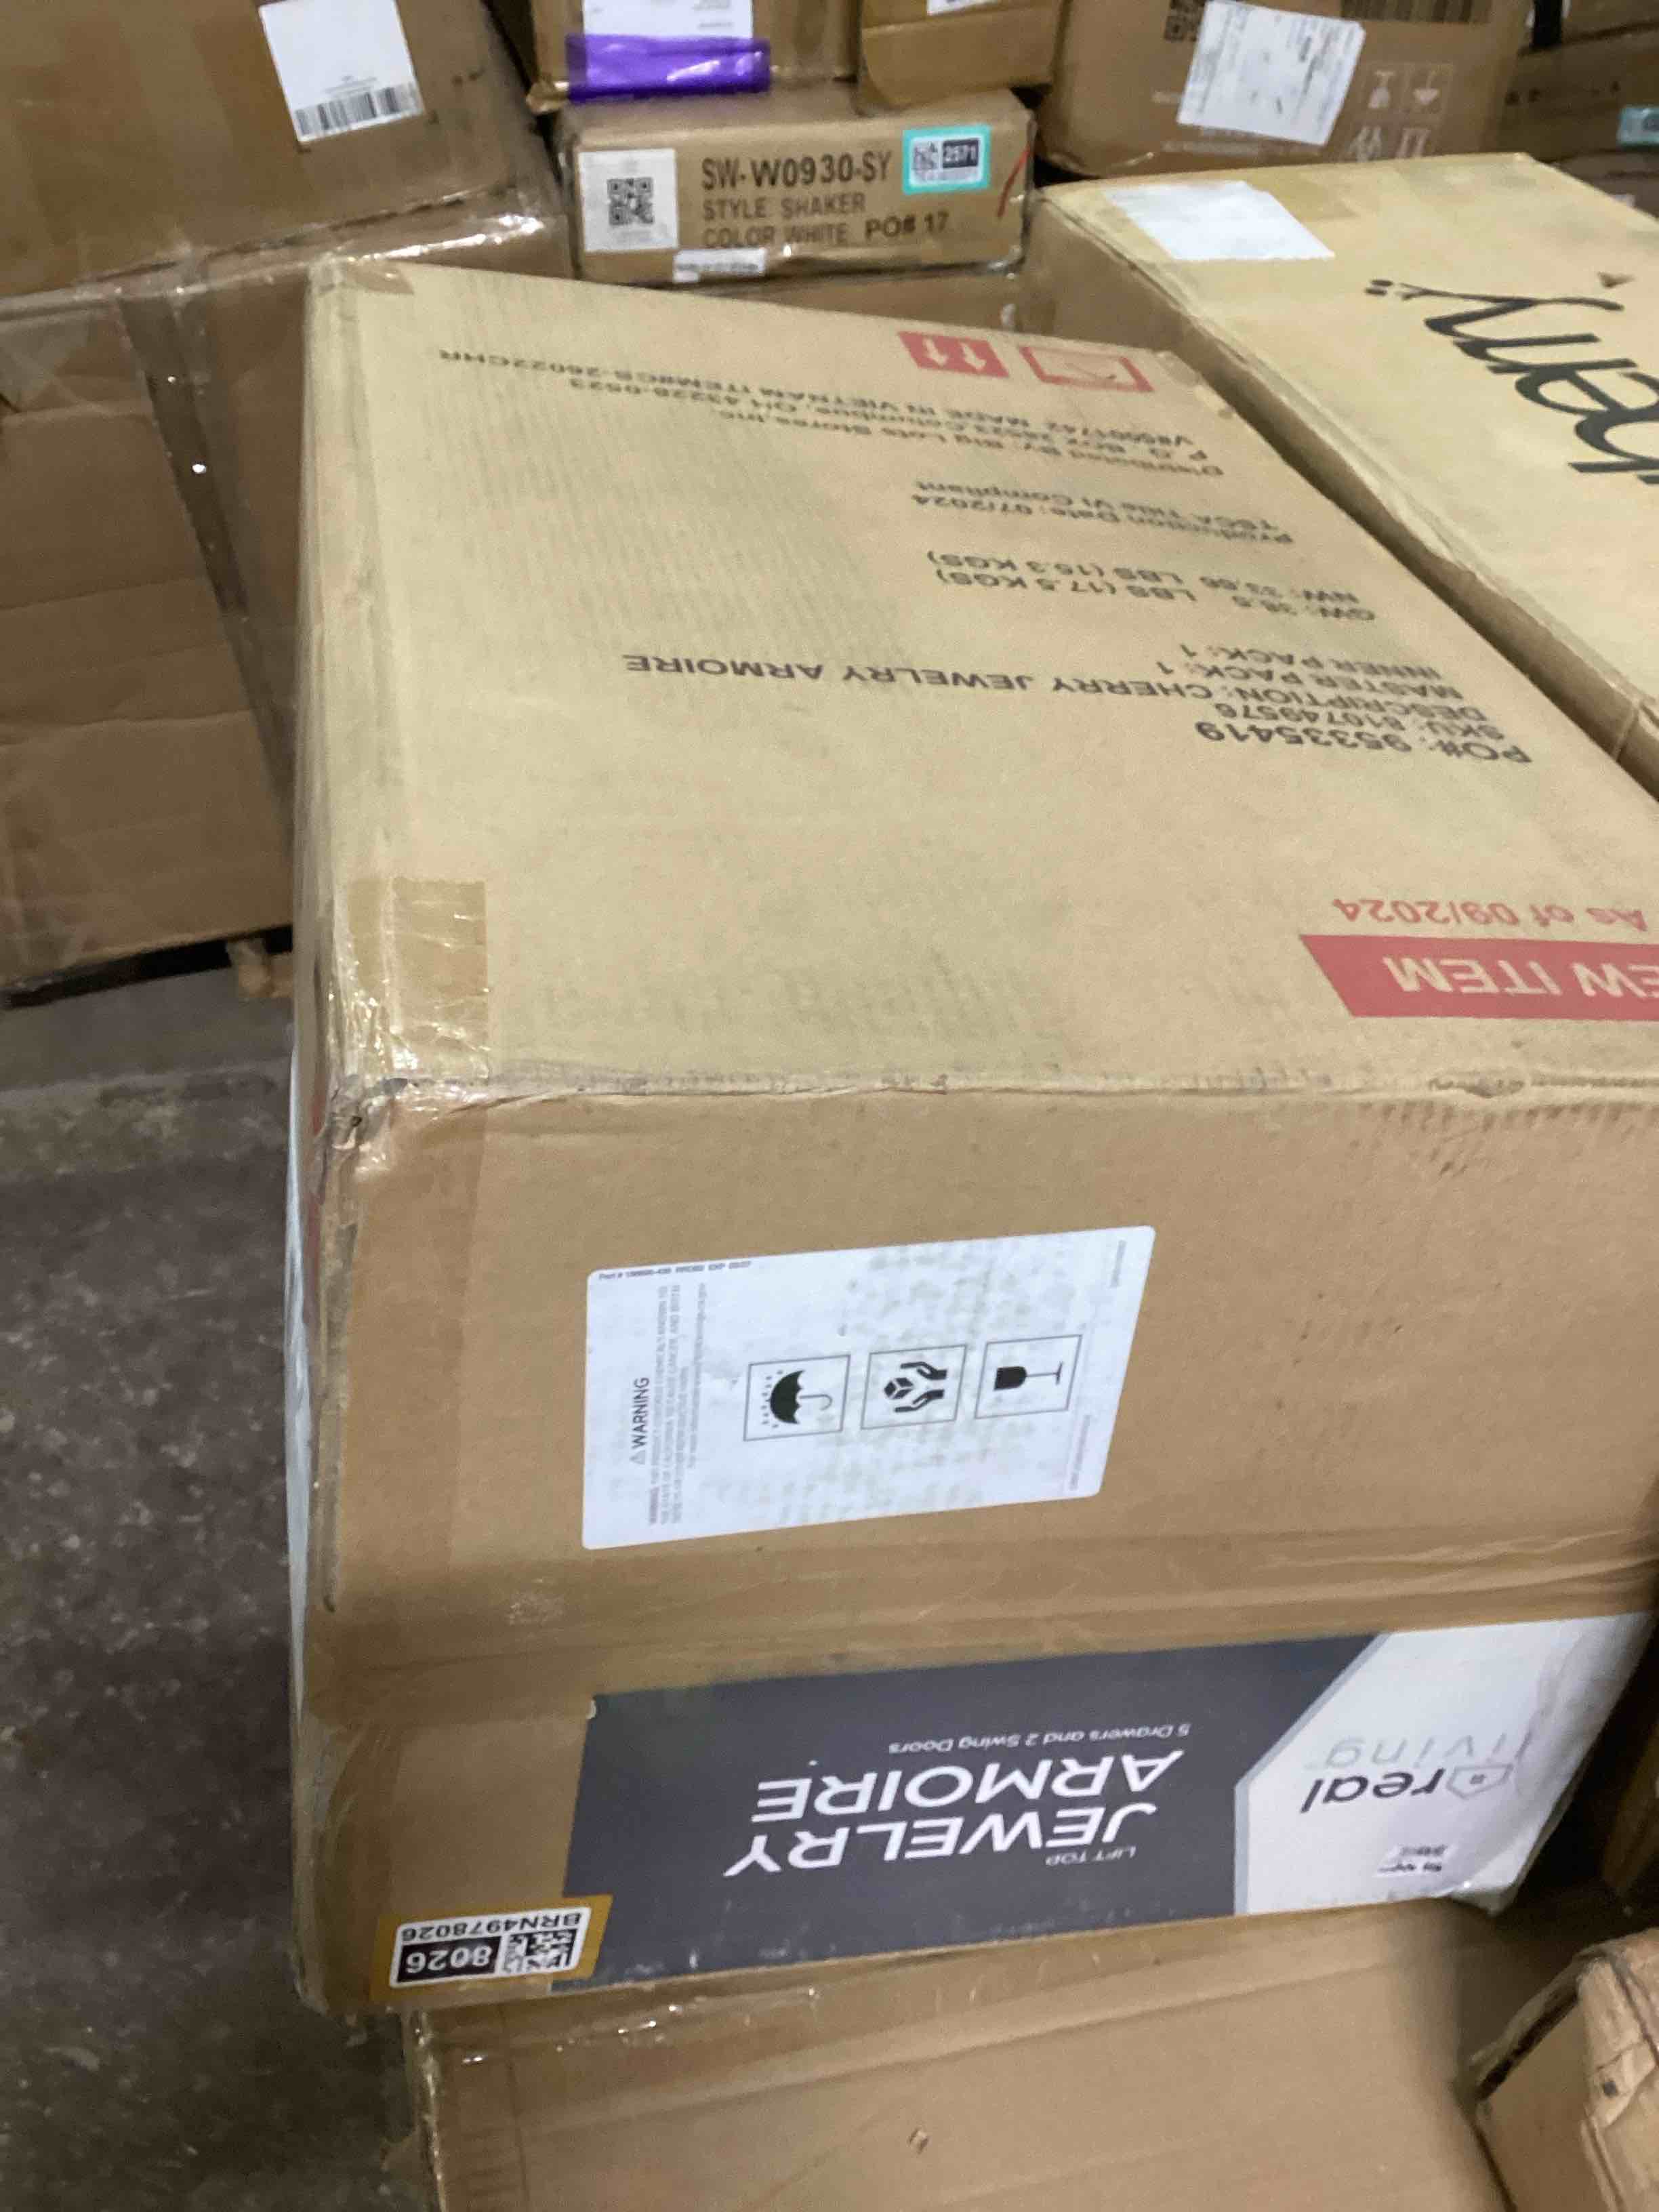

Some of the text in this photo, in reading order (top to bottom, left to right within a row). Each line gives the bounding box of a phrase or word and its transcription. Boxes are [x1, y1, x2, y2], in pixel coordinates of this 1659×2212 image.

[701, 150, 892, 190] SW-W0930-SY
[703, 192, 867, 221] STYLE SHAKER
[703, 223, 848, 248] COLOR WHITE
[924, 211, 949, 234] 17
[759, 387, 901, 411] VIETNAM
[911, 494, 1033, 516] 07/2024
[913, 480, 1073, 507] Compliant
[927, 550, 1017, 572] KGS)
[937, 569, 1028, 590] KGS)
[1113, 567, 1183, 586] LBS
[1126, 585, 1197, 602] LBS
[1179, 644, 1441, 680] INNER PACK: 1
[622, 654, 1487, 722] DESCRIPTION: CHERRY JEWELRY ARMOIRE
[1155, 661, 1463, 700] MASTER PACK: 1
[1194, 721, 1532, 764] PO#: 95335419
[1420, 721, 1506, 741] SKU:
[1332, 898, 1647, 933] As of 09/2024
[1382, 956, 1563, 996] ITEM
[630, 1376, 650, 1449] WARNING
[888, 1723, 1191, 1754] 5 Drawers and 2 Swing Doors
[750, 1750, 1184, 1822] ARMOIRE
[1299, 1768, 1446, 1814] real
[722, 1802, 1157, 1877] JEWELRY
[1045, 1845, 1137, 1866] LIFT TOP
[401, 1912, 582, 1942] BRN4978026
[405, 1945, 493, 1974] 8026
